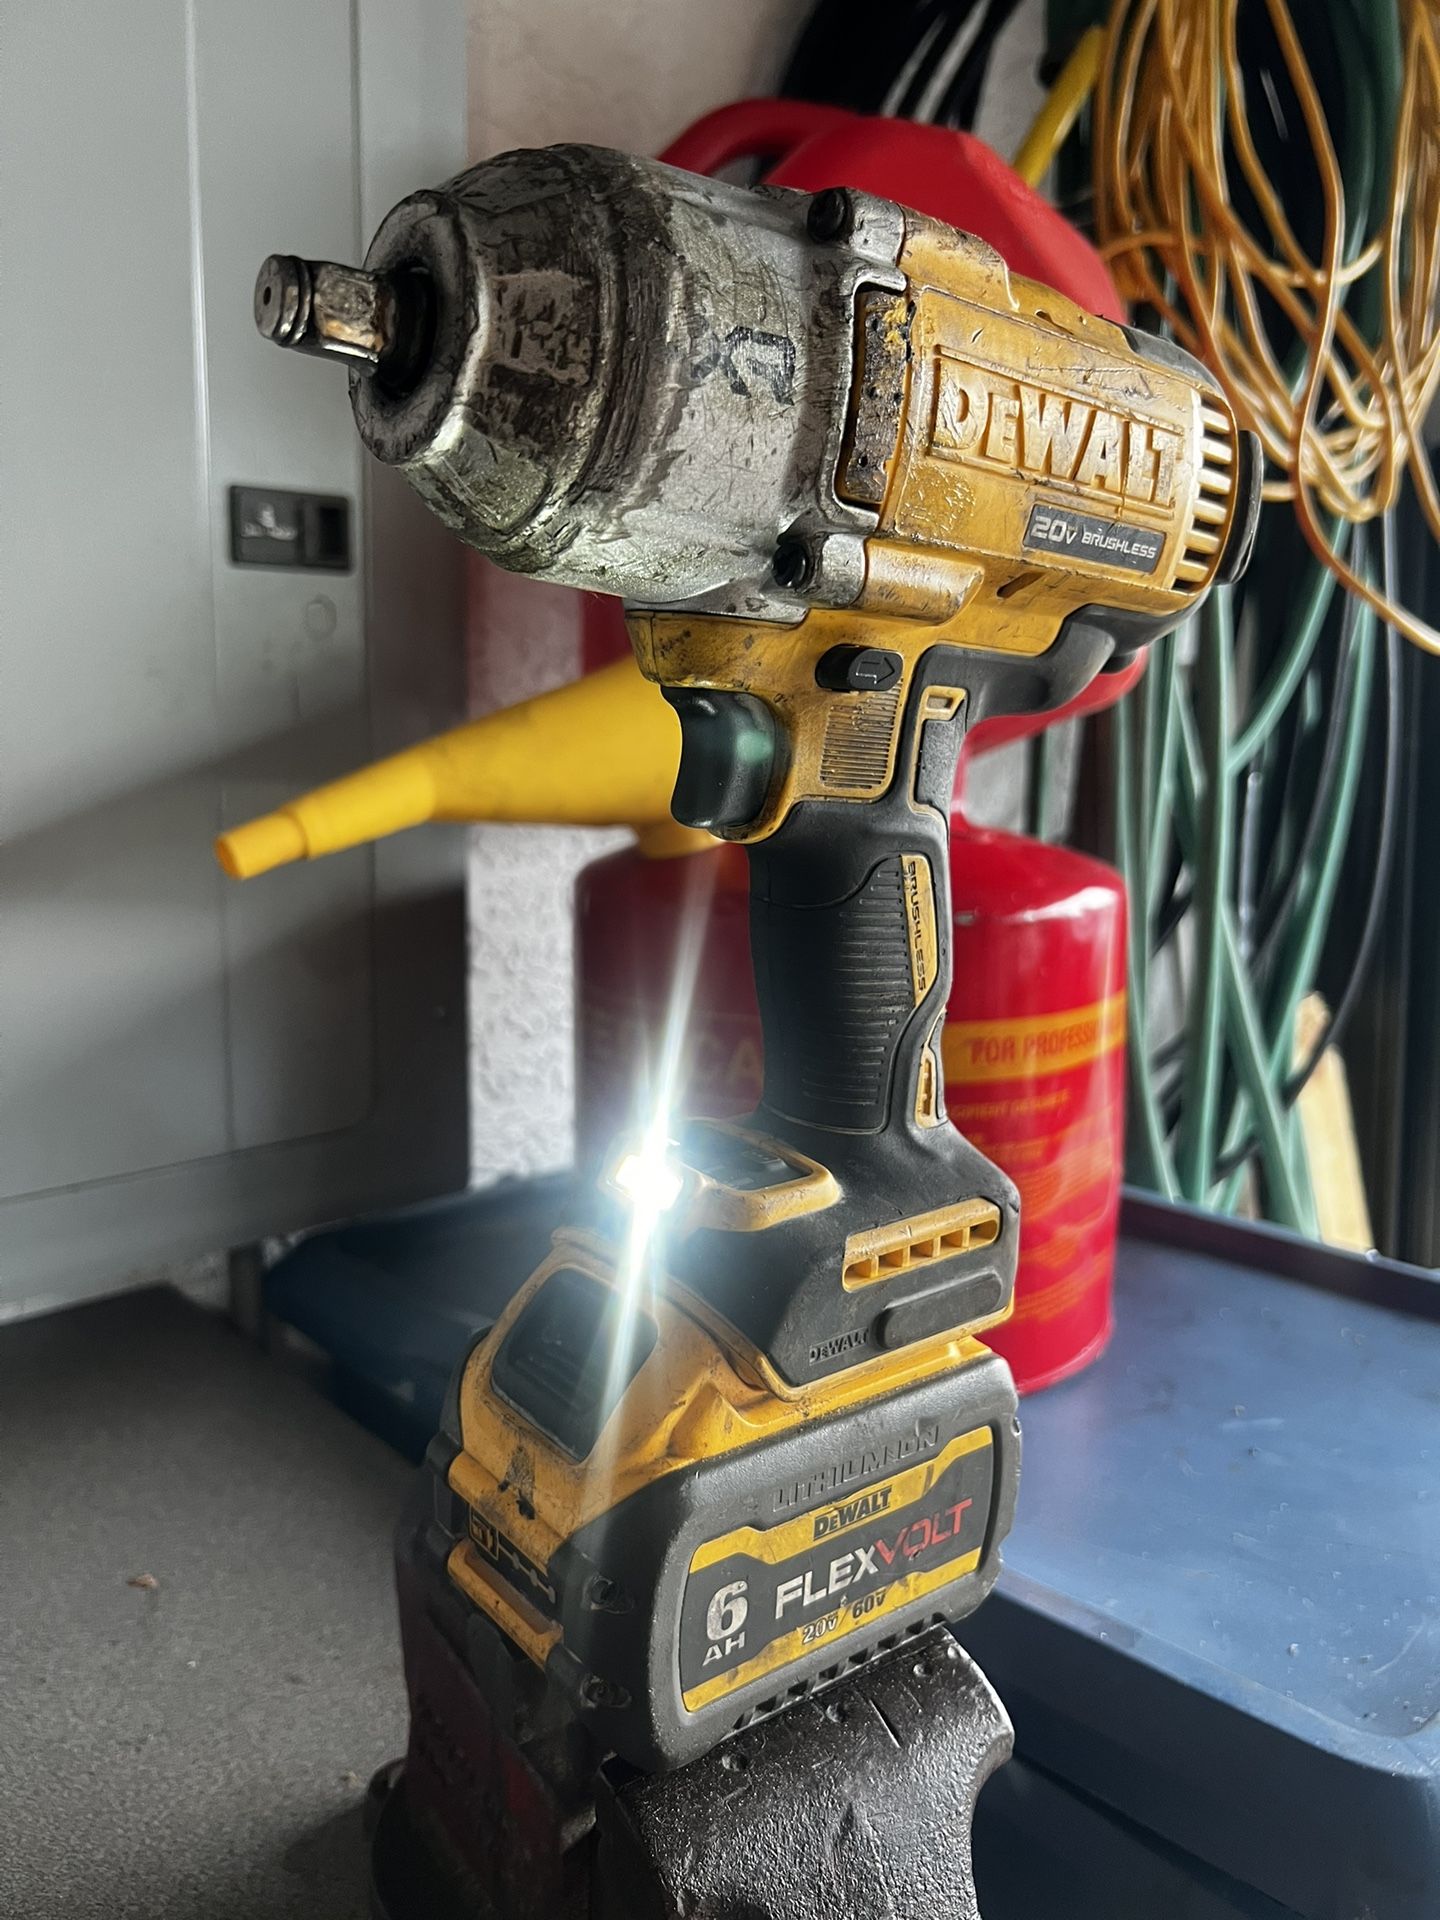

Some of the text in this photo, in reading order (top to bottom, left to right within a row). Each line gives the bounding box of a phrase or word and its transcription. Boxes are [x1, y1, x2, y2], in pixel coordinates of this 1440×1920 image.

[933, 378, 1180, 507] DEWALT
[1081, 532, 1158, 560] BRUSHLESS
[908, 860, 926, 992] BRUSHLESS
[967, 1035, 1016, 1065] FOR
[809, 1329, 868, 1363] DEWALT
[814, 1487, 891, 1540] DEWALT
[775, 1499, 972, 1620] FLEXVOLT
[706, 1580, 748, 1641] 6
[702, 1632, 746, 1667] AH
